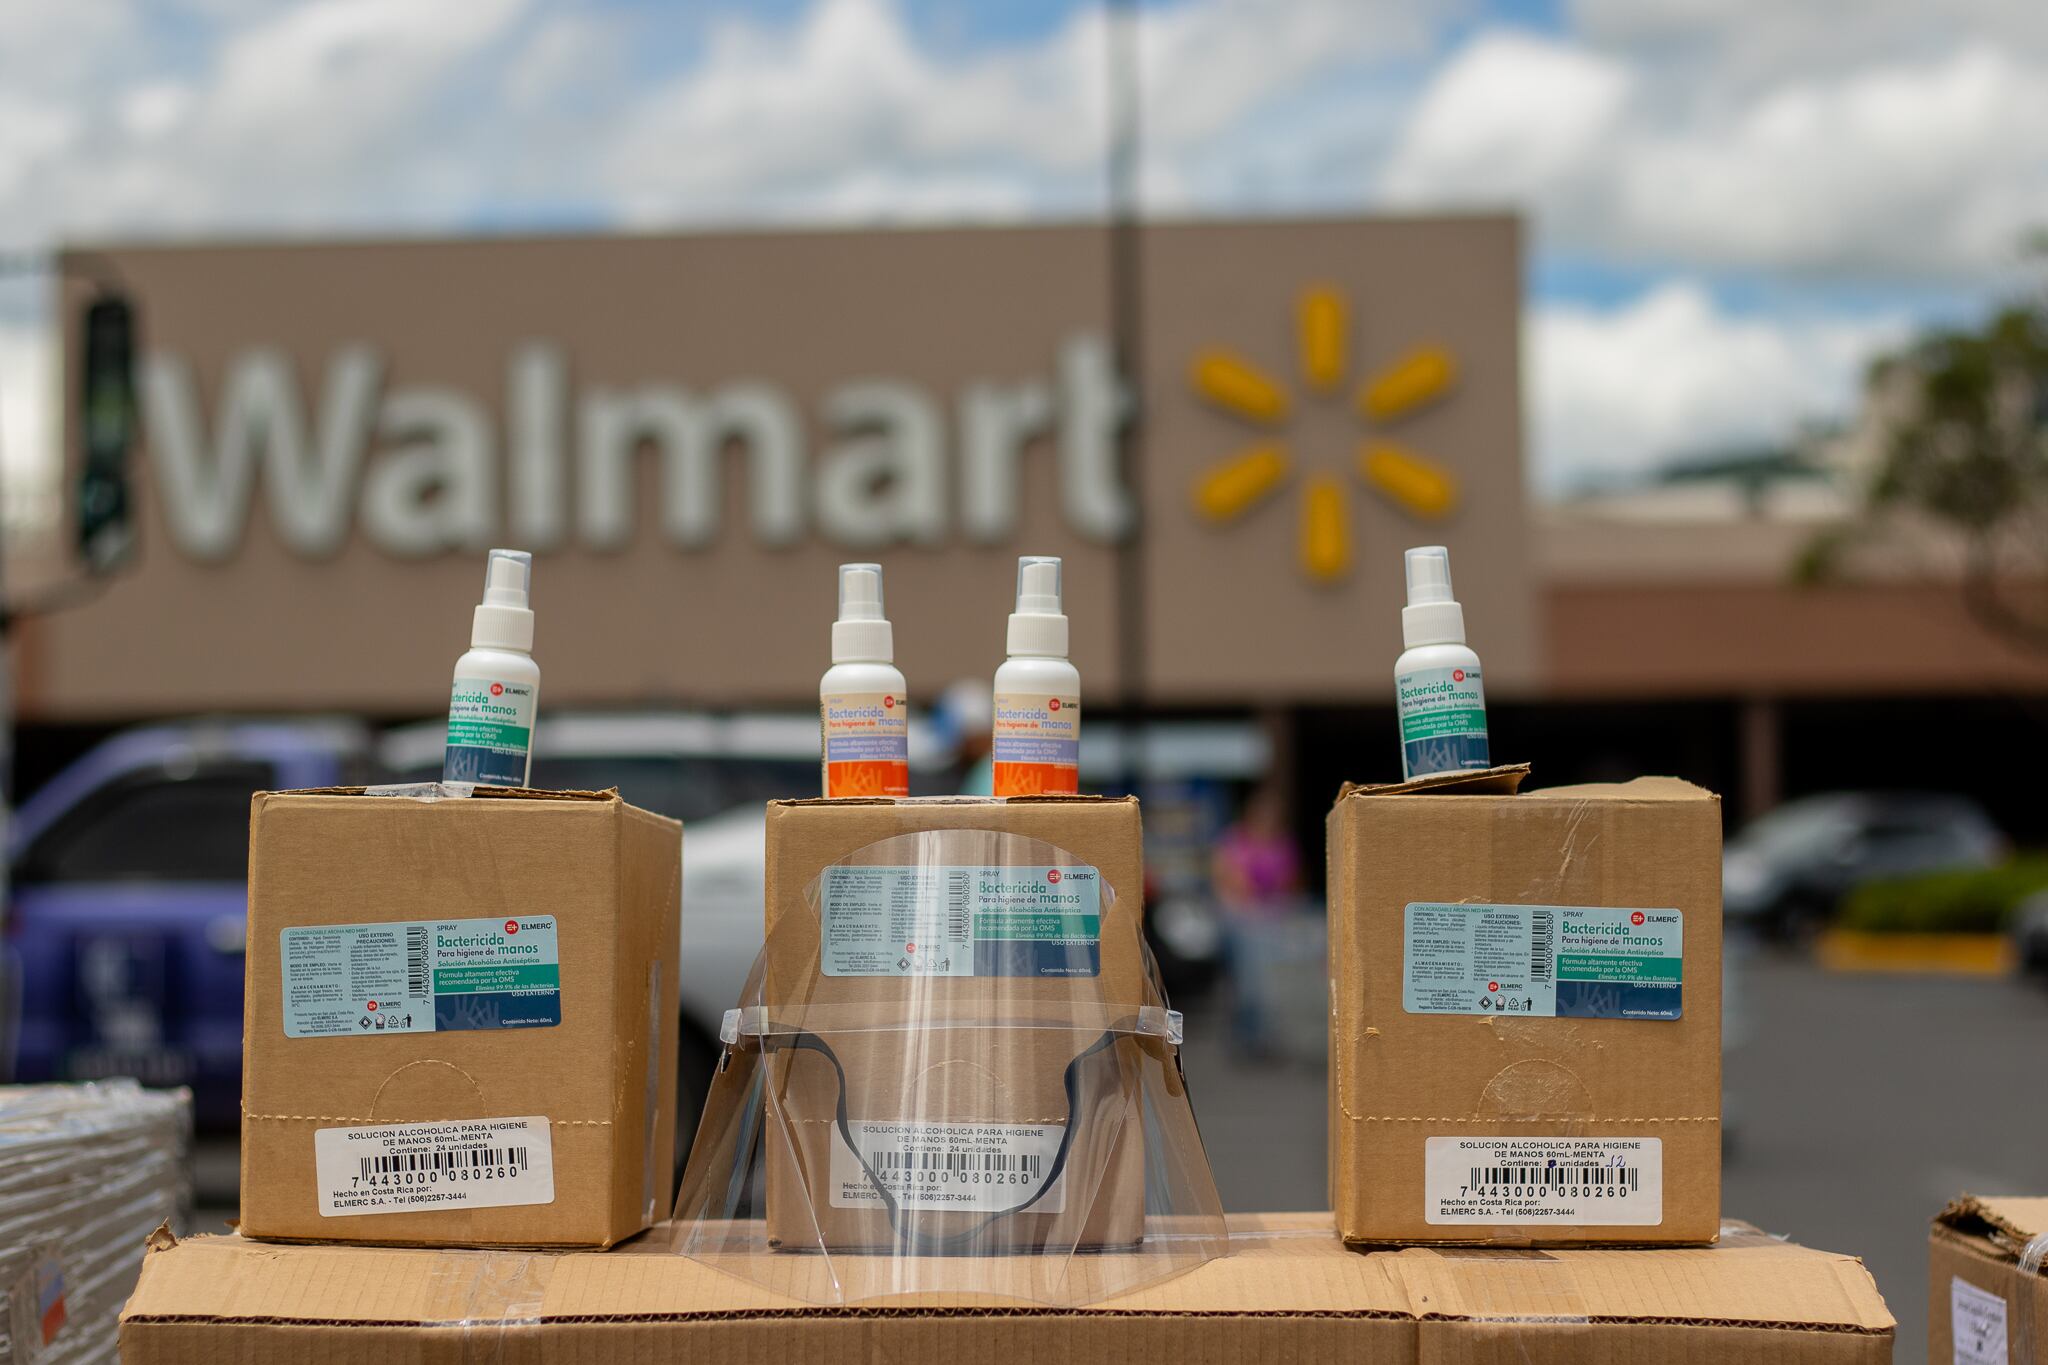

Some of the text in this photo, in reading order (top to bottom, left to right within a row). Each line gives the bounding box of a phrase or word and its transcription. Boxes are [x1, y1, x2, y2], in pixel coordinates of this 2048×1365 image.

[141, 334, 1138, 559] Walmart
[1400, 680, 1454, 699] Bactericida
[1413, 697, 1436, 706] higiene
[1449, 691, 1478, 700] manos
[481, 704, 517, 715] manos
[829, 705, 884, 719] Bactericida
[997, 708, 1048, 720] Bactericida
[1041, 721, 1072, 730] manos
[979, 880, 1046, 893] Bactericida
[998, 895, 1025, 904] higiene
[1040, 894, 1079, 903] manos
[1562, 921, 1629, 935] Bactericida
[420, 928, 429, 960] 080260
[437, 932, 504, 947] Bactericida
[1561, 935, 1662, 946] Para higiene de manos
[437, 944, 538, 958] Para higiene de manos
[1627, 948, 1663, 956] Antiséptica
[437, 959, 465, 967] Solución
[503, 956, 539, 965] Antiséptica
[421, 962, 430, 994] 443000
[348, 1121, 527, 1140] SOLUCION ALCOHOLICA PARA HIGIENE
[1005, 1129, 1043, 1137] HIGIENE
[398, 1136, 431, 1145] MANOS
[389, 1145, 430, 1154] Contiene:
[448, 1141, 487, 1150] unidades
[352, 1177, 358, 1187] 7
[369, 1172, 437, 1186] 443000
[333, 1189, 358, 1197] Hecho
[371, 1187, 394, 1195] Costa
[1461, 1186, 1626, 1196] 7 443000 080260
[333, 1198, 368, 1207] ELMERC
